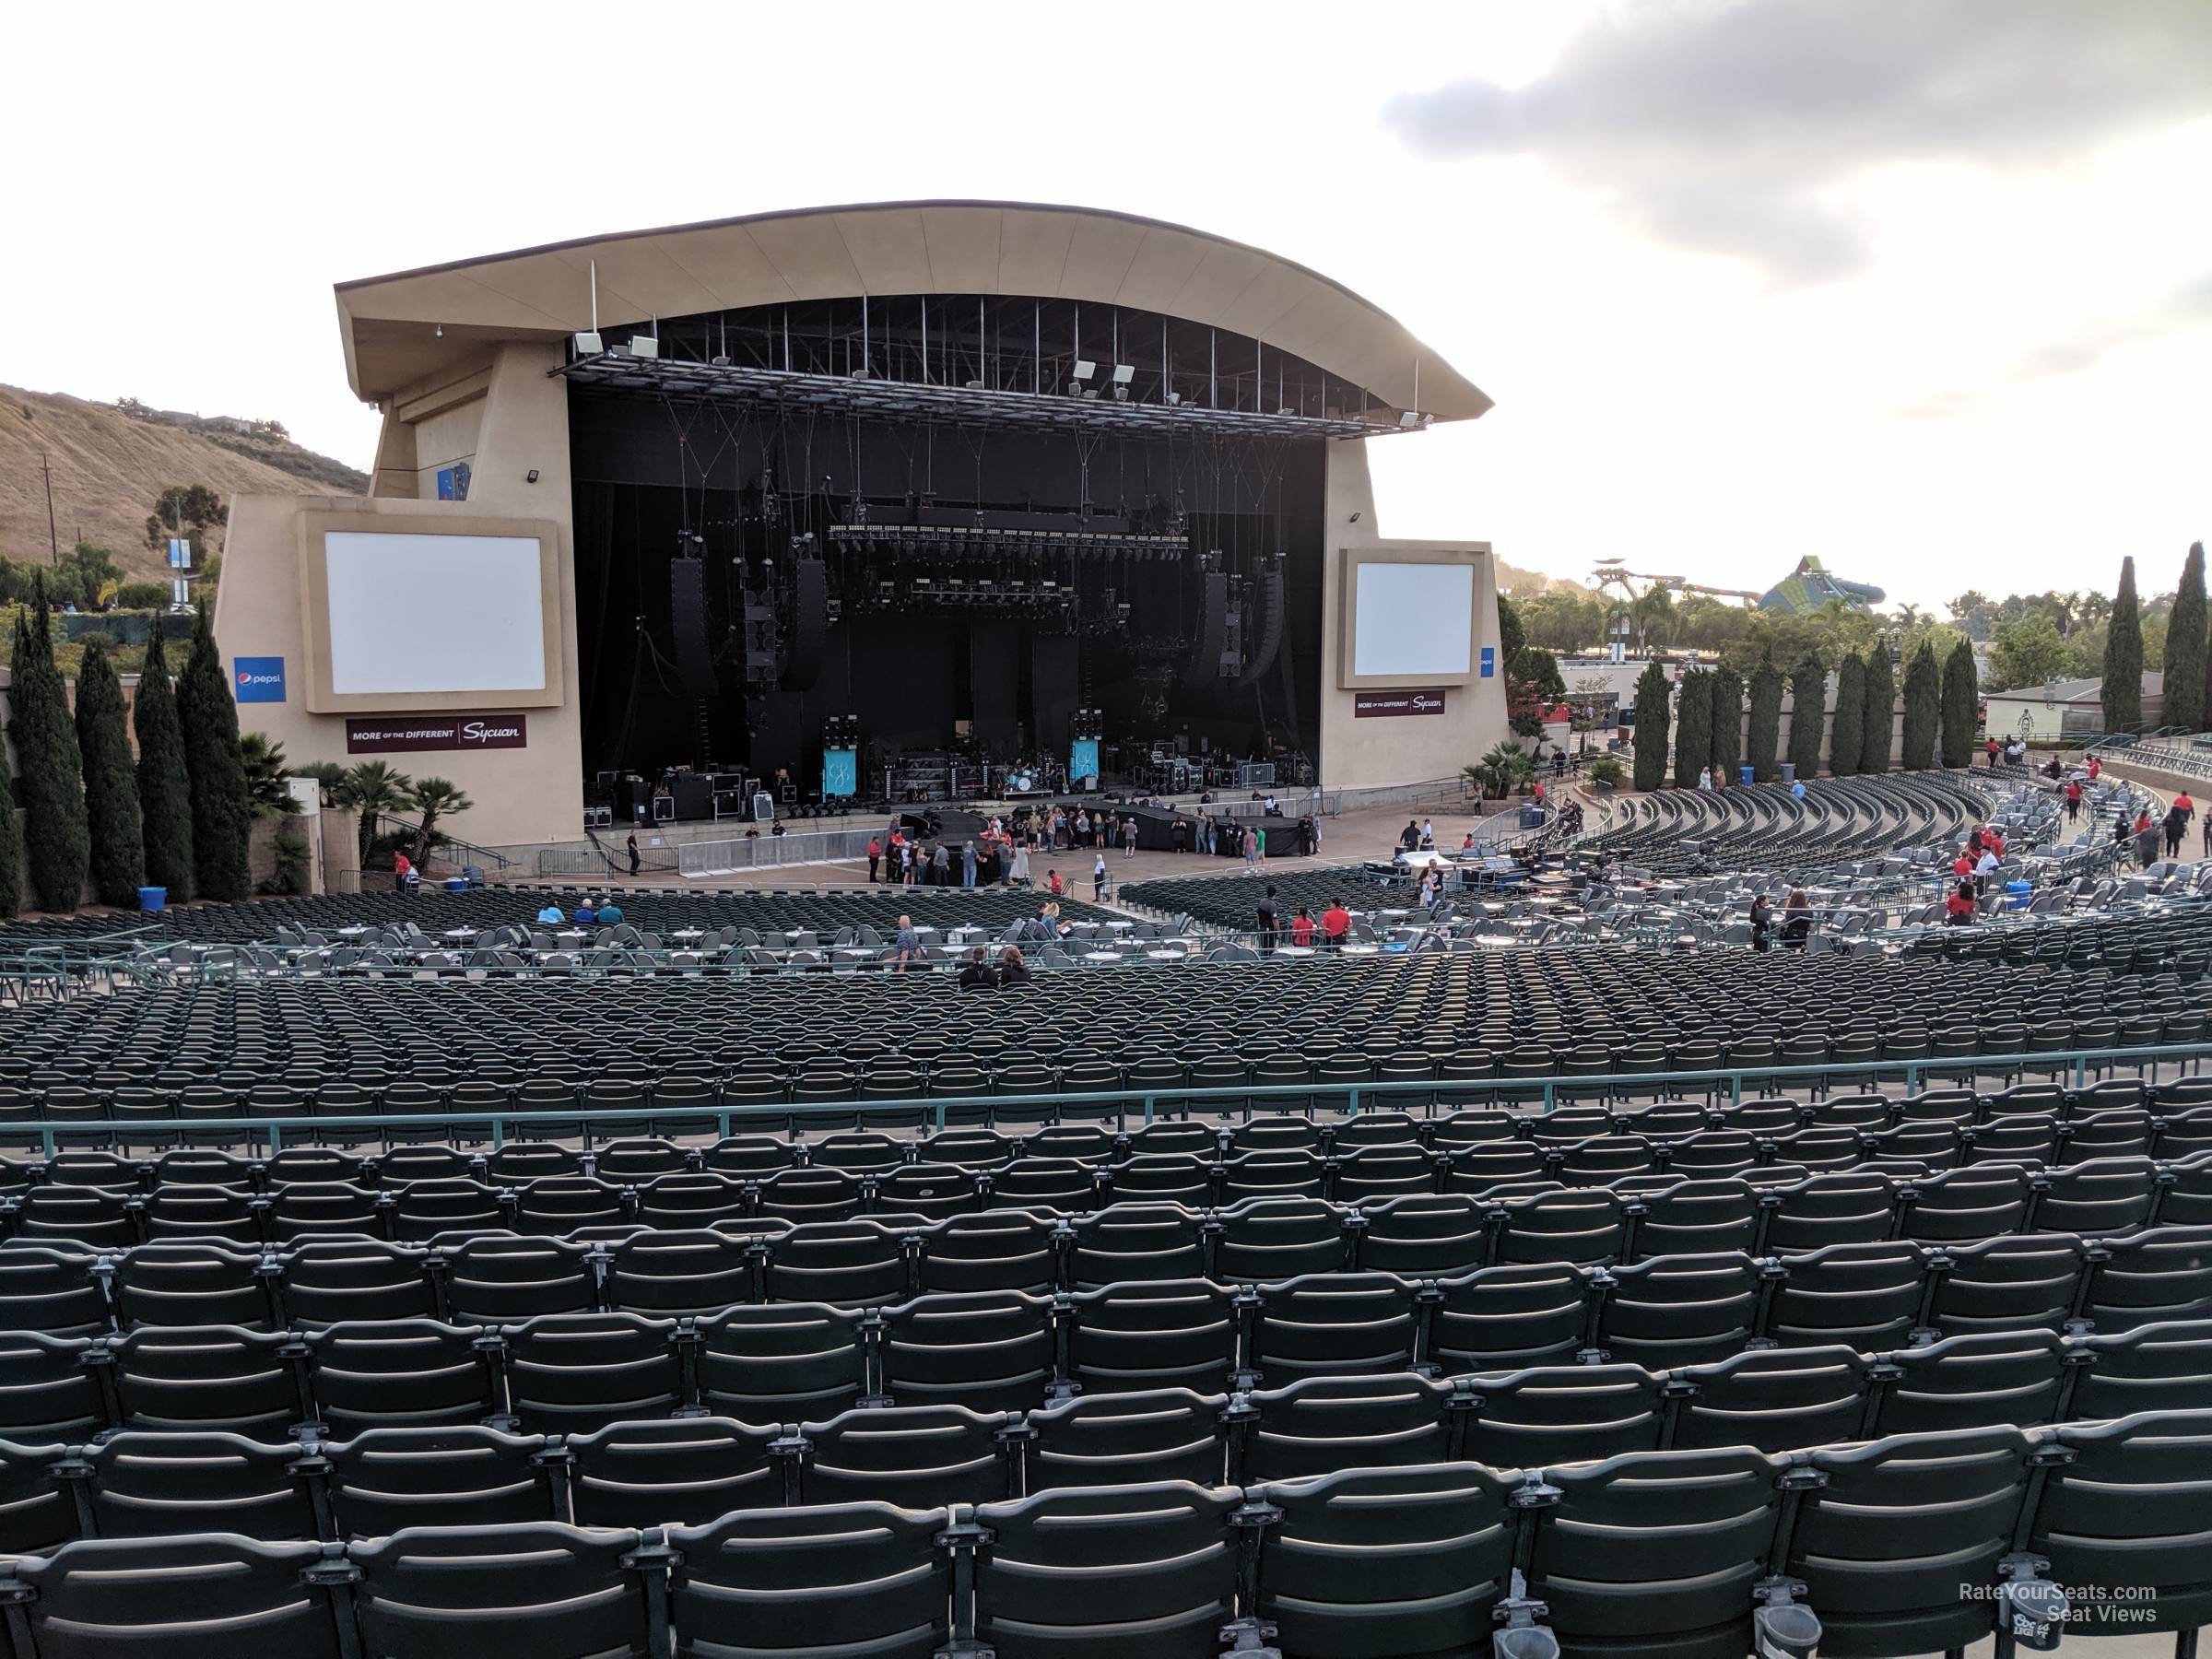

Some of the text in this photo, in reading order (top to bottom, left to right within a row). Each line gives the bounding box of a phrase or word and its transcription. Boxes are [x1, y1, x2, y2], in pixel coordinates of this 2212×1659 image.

[253, 674, 280, 684] pepsi
[1412, 695, 1442, 712] Sycuan
[352, 732, 382, 741] MORE
[406, 729, 454, 739] DIFFERENT
[464, 722, 520, 743] Sycuan
